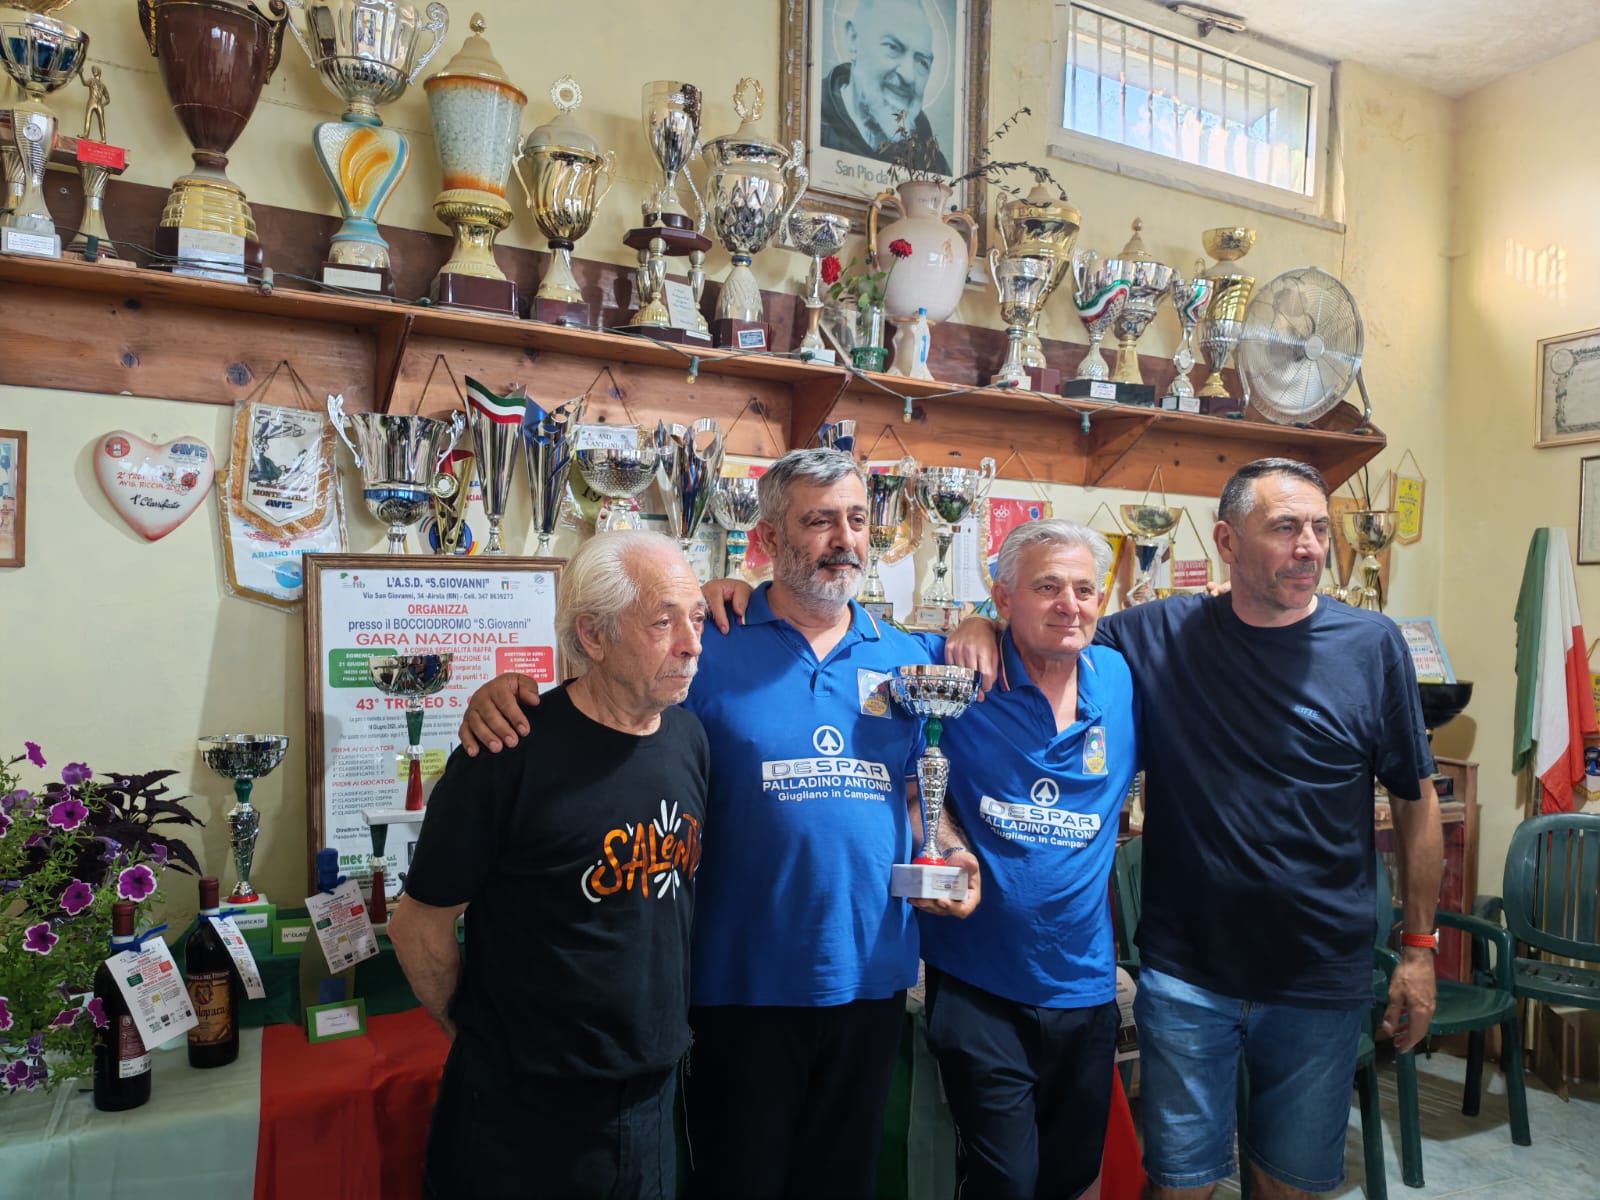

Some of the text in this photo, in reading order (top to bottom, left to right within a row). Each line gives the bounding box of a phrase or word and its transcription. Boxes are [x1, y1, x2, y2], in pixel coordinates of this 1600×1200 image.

[836, 160, 855, 177] San
[857, 165, 874, 182] Pio
[876, 170, 888, 185] da
[265, 500, 293, 509] AVIS
[252, 550, 288, 560] ARIANO
[408, 604, 469, 615] ORGANIZZA
[348, 620, 383, 632] presso
[393, 618, 472, 630] BOCCIODROMO
[356, 632, 520, 646] GARA NAZIONALE
[356, 698, 379, 711] 43°
[449, 696, 462, 708] S.
[771, 759, 884, 778] DESPAR
[762, 775, 893, 793] PALLADINO ANTONIO
[777, 789, 886, 801] Giugliano in Campania
[987, 801, 1094, 828] DESPAR
[340, 853, 363, 866] mec
